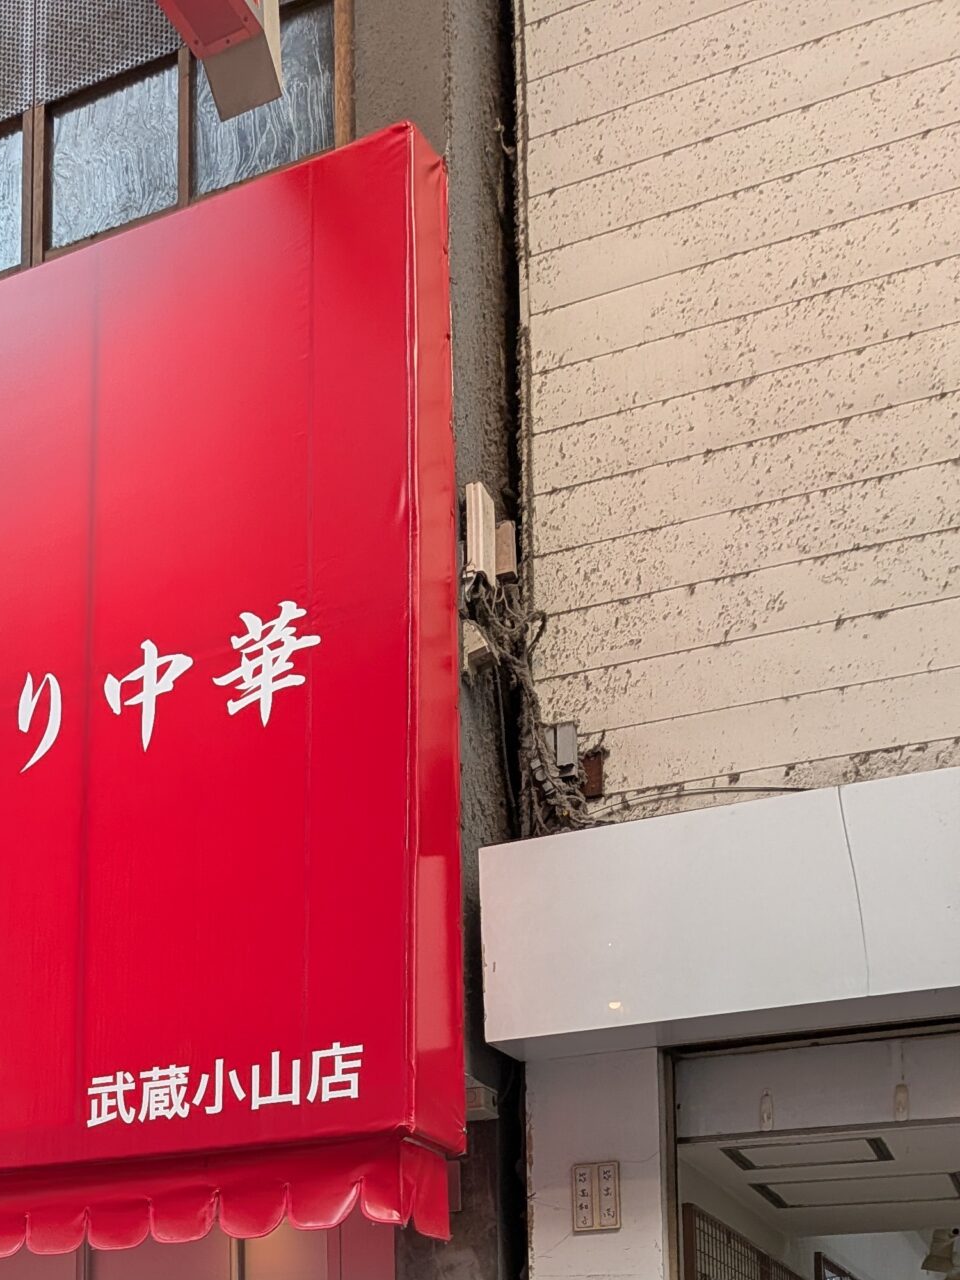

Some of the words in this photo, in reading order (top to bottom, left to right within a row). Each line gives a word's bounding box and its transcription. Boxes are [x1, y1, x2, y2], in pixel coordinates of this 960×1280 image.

[86, 1042, 363, 1127] 武蔵小山店
